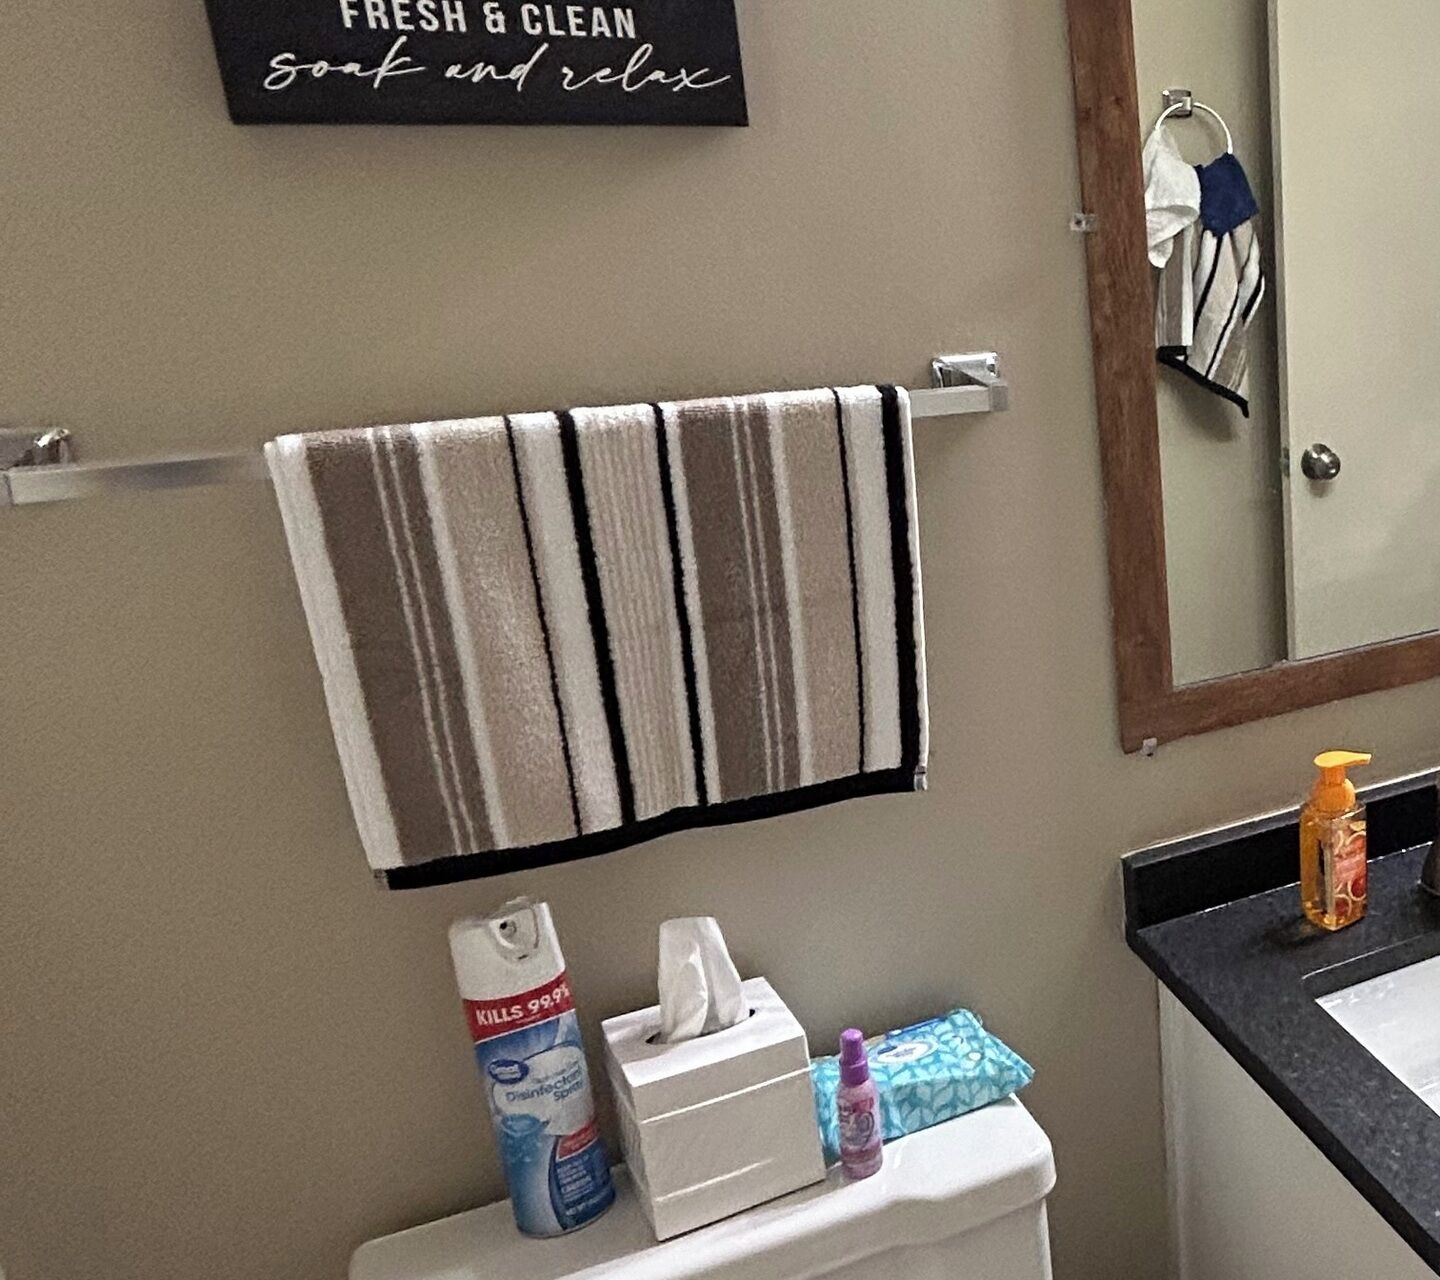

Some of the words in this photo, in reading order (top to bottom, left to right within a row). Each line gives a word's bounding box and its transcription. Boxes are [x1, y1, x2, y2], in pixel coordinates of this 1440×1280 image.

[484, 1, 505, 34] &
[520, 2, 636, 39] CLEAN
[263, 35, 427, 90] soak
[443, 42, 549, 92] and
[560, 44, 732, 92] relax
[475, 1005, 523, 1026] KILLS
